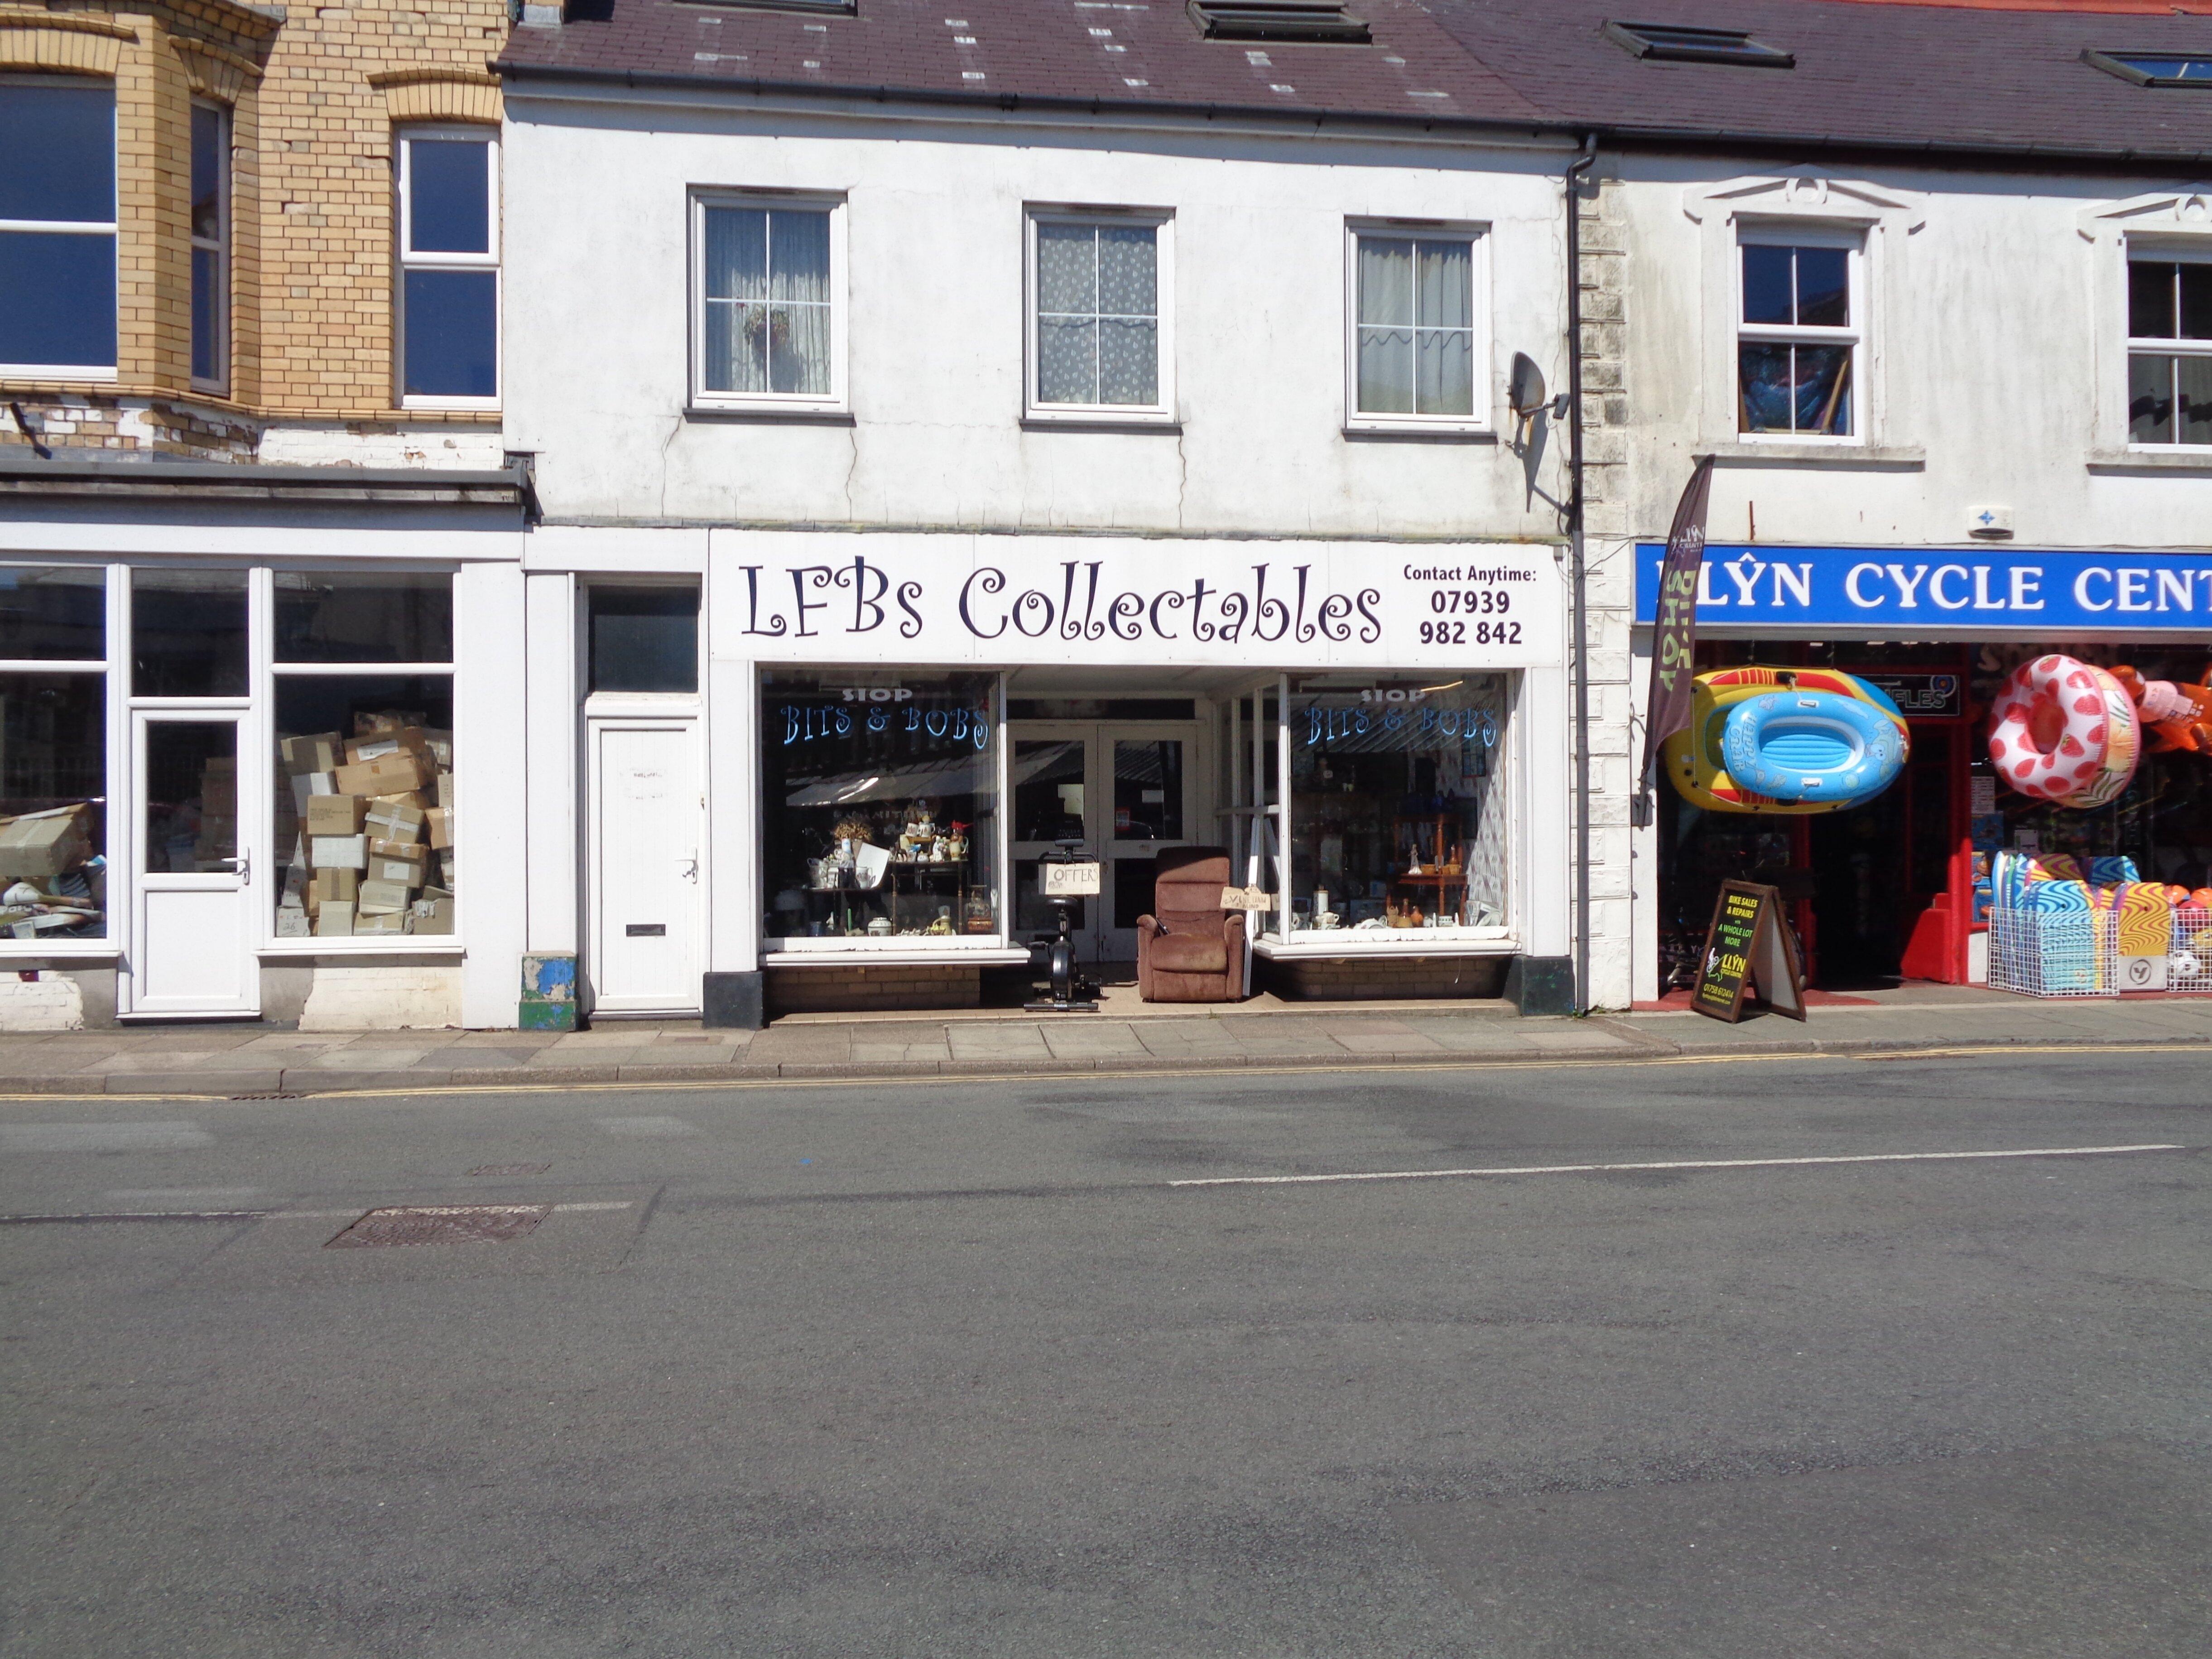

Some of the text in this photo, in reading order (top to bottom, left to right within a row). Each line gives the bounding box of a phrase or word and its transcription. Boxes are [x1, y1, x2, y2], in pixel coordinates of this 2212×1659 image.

[1404, 564, 1537, 583] Contact Anytime:
[1656, 552, 1813, 607] LŶN
[1845, 563, 2045, 610] CYCLE
[738, 555, 1381, 644] LFBs Collectables
[1431, 590, 1510, 614] 07939
[1419, 622, 1522, 645] 982 842
[842, 688, 913, 703] SIOP
[1361, 689, 1426, 702] SIOP
[780, 705, 989, 750] BITS & BOBS
[1304, 707, 1496, 748] BITS & BOBS
[1054, 868, 1099, 882] OFFERS
[1728, 895, 1758, 908] BIKE SALES
[1732, 907, 1754, 918] REPAIRS
[1718, 923, 1753, 938] A WHOLE LOT
[1725, 936, 1741, 946] MORE
